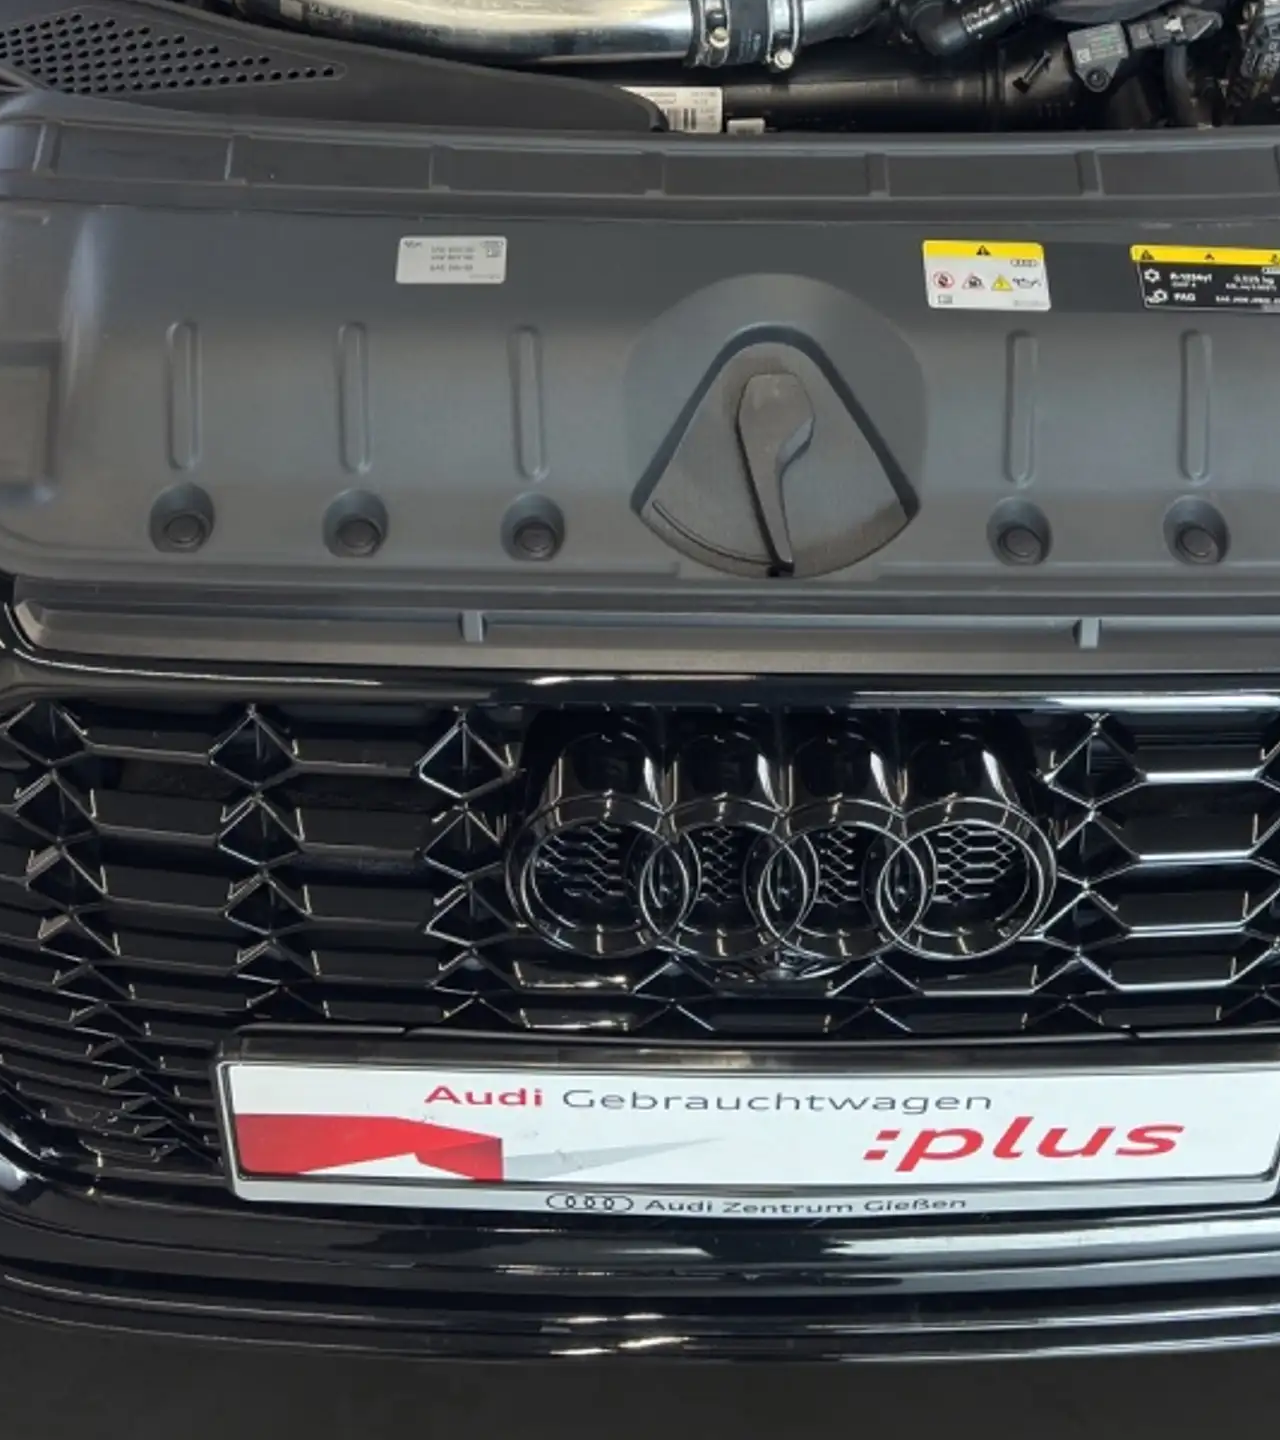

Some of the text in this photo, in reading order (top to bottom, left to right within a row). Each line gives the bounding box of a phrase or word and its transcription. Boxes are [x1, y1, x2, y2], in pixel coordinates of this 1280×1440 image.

[423, 1084, 993, 1116] Audi Gebrauchtwagen
[863, 1116, 1185, 1172] :plus
[644, 1198, 968, 1214] Audi Zentrum Gießen
